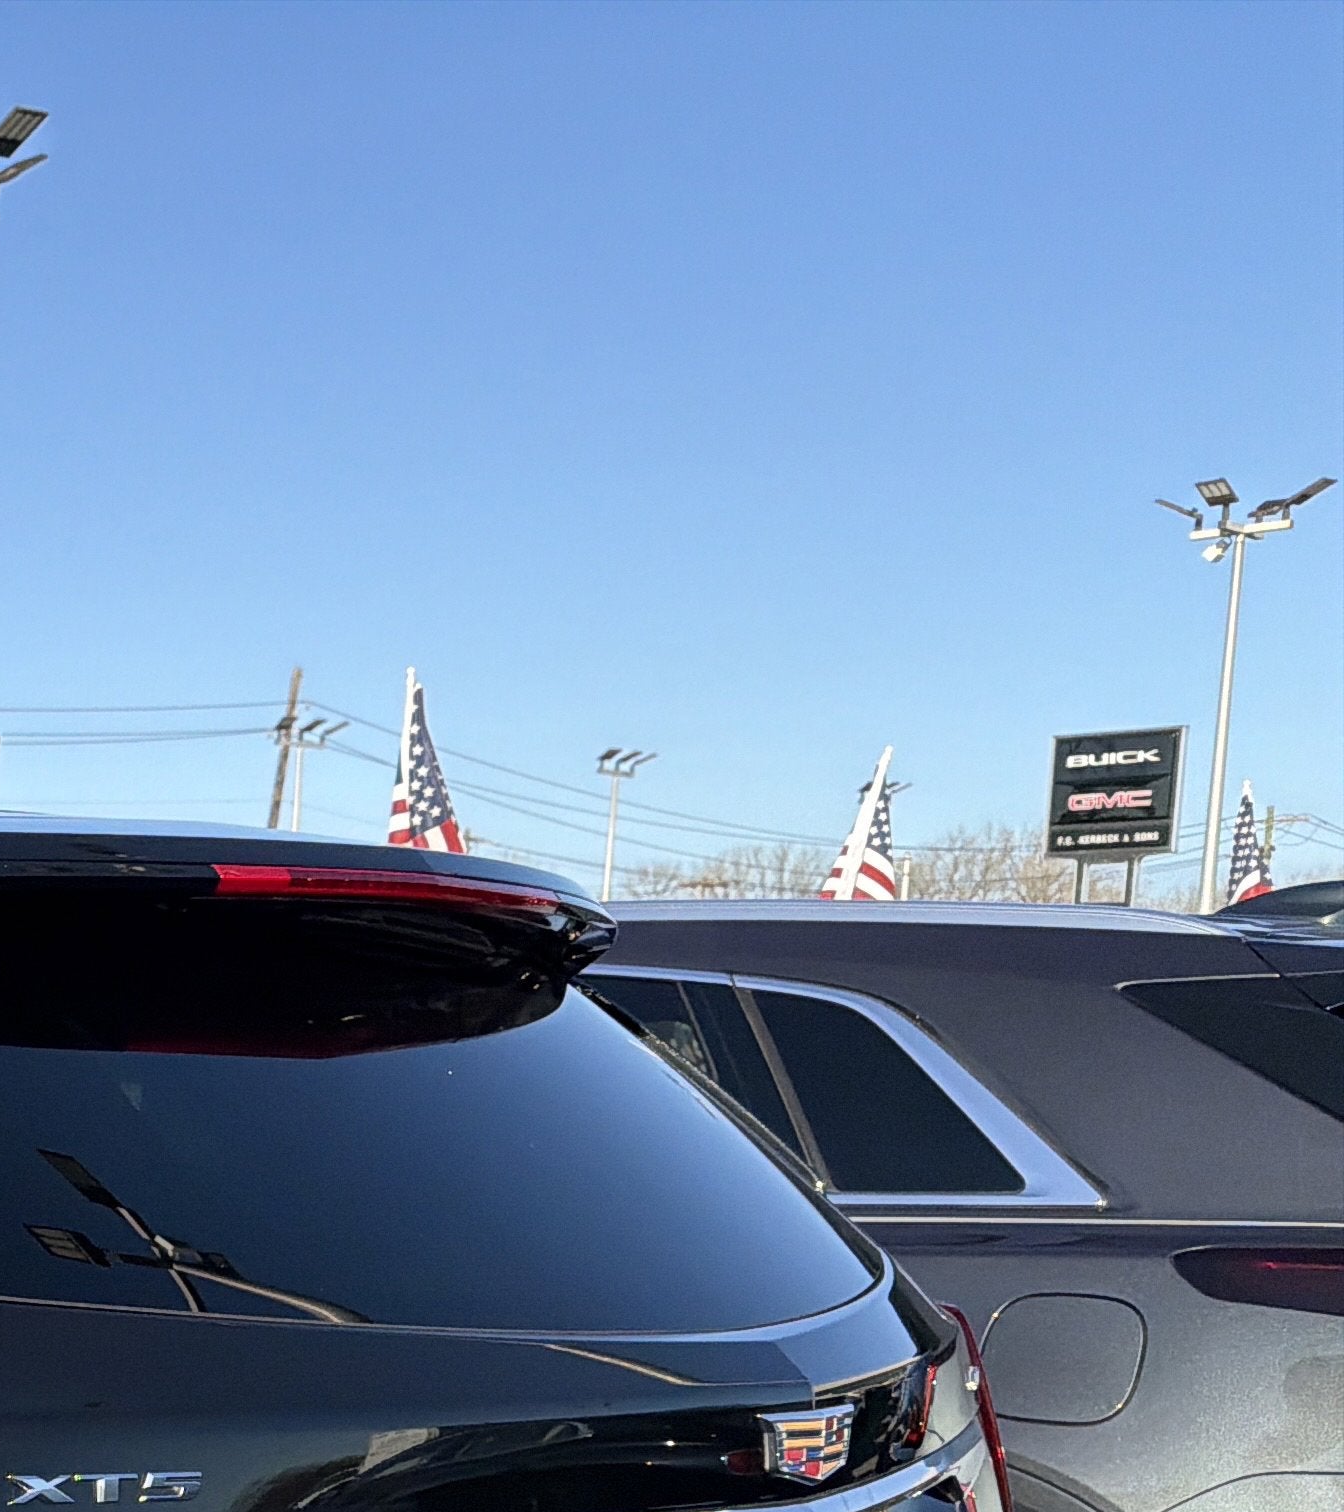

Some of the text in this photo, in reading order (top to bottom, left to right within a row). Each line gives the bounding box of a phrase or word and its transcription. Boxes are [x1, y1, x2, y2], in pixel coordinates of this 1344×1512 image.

[1065, 748, 1161, 769] BUICK
[1067, 789, 1153, 812] GMC
[1133, 831, 1160, 842] SONS
[5, 1471, 203, 1506] XT5
